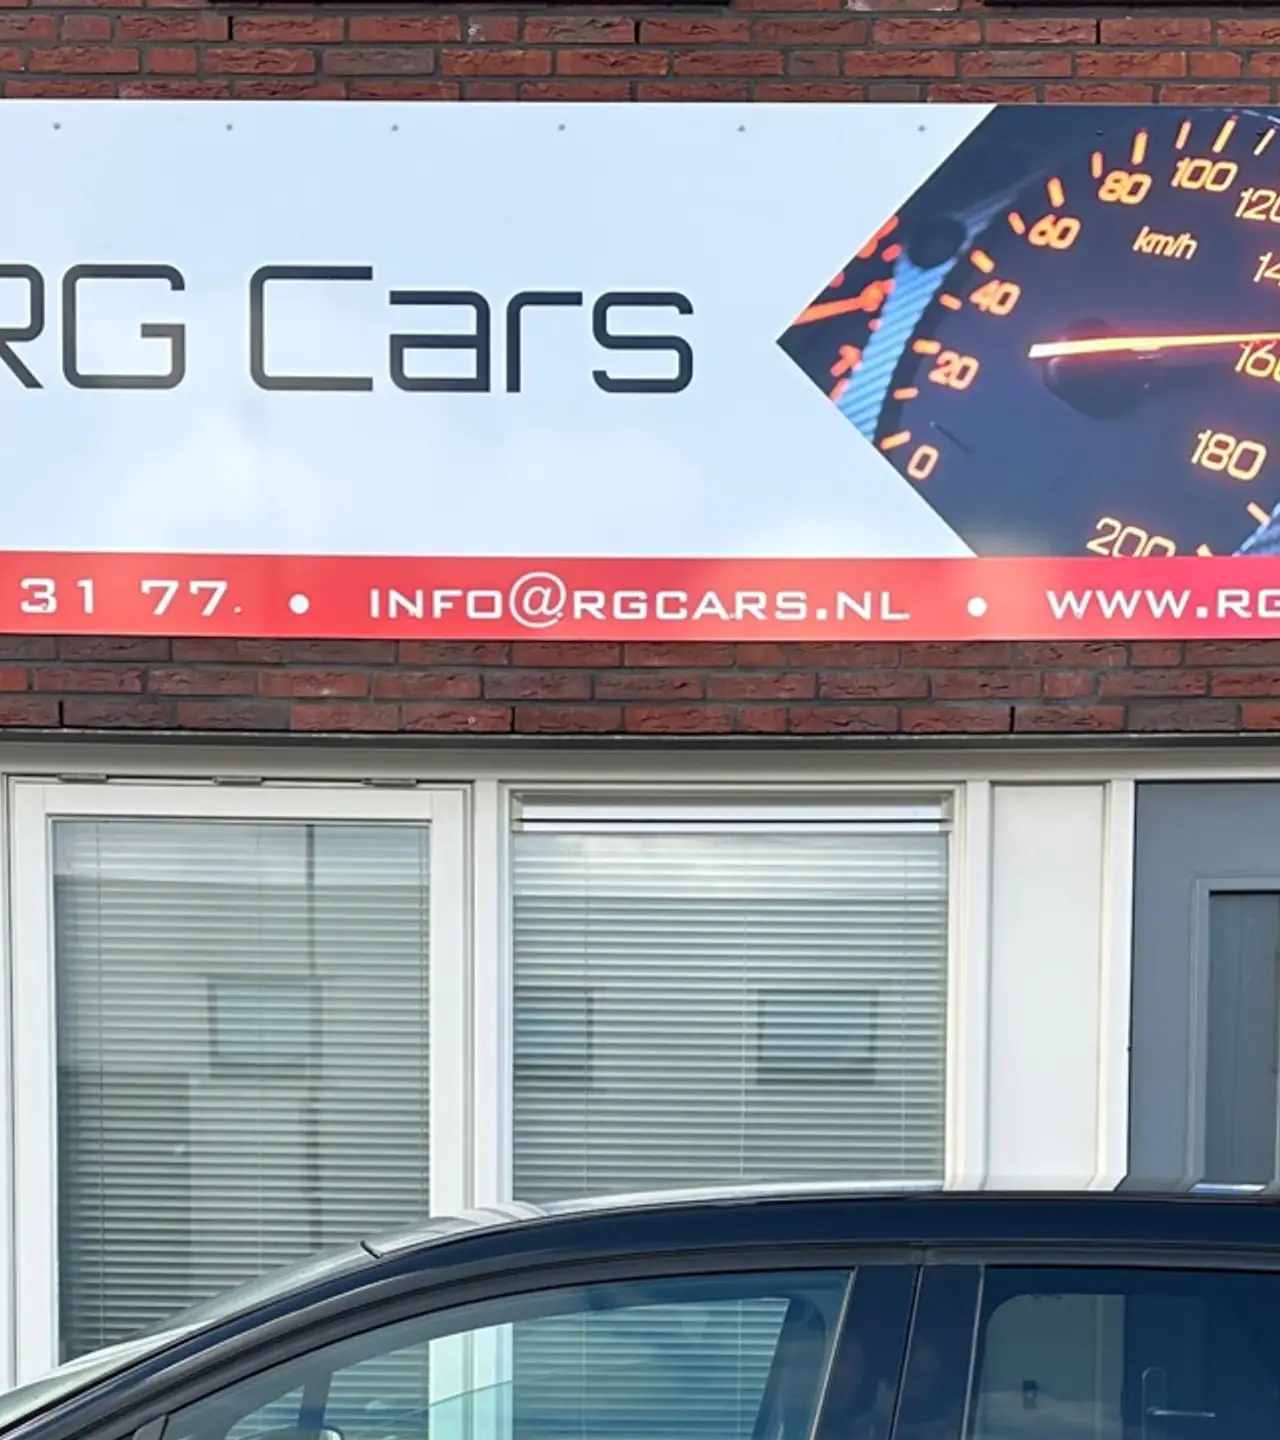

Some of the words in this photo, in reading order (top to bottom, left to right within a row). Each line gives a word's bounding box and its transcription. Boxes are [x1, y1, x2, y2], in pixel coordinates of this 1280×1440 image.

[1098, 169, 1152, 205] 80
[1170, 157, 1237, 192] 100
[1028, 215, 1081, 250] 60
[1132, 224, 1199, 260] km/h
[969, 278, 1021, 316] 40
[250, 265, 694, 393] Cars
[928, 350, 980, 391] 20
[906, 444, 940, 481] 0
[1190, 428, 1267, 481] 180
[19, 578, 95, 615] 31
[140, 579, 229, 616] 77
[371, 571, 910, 629] INFO@RGCARS.NL
